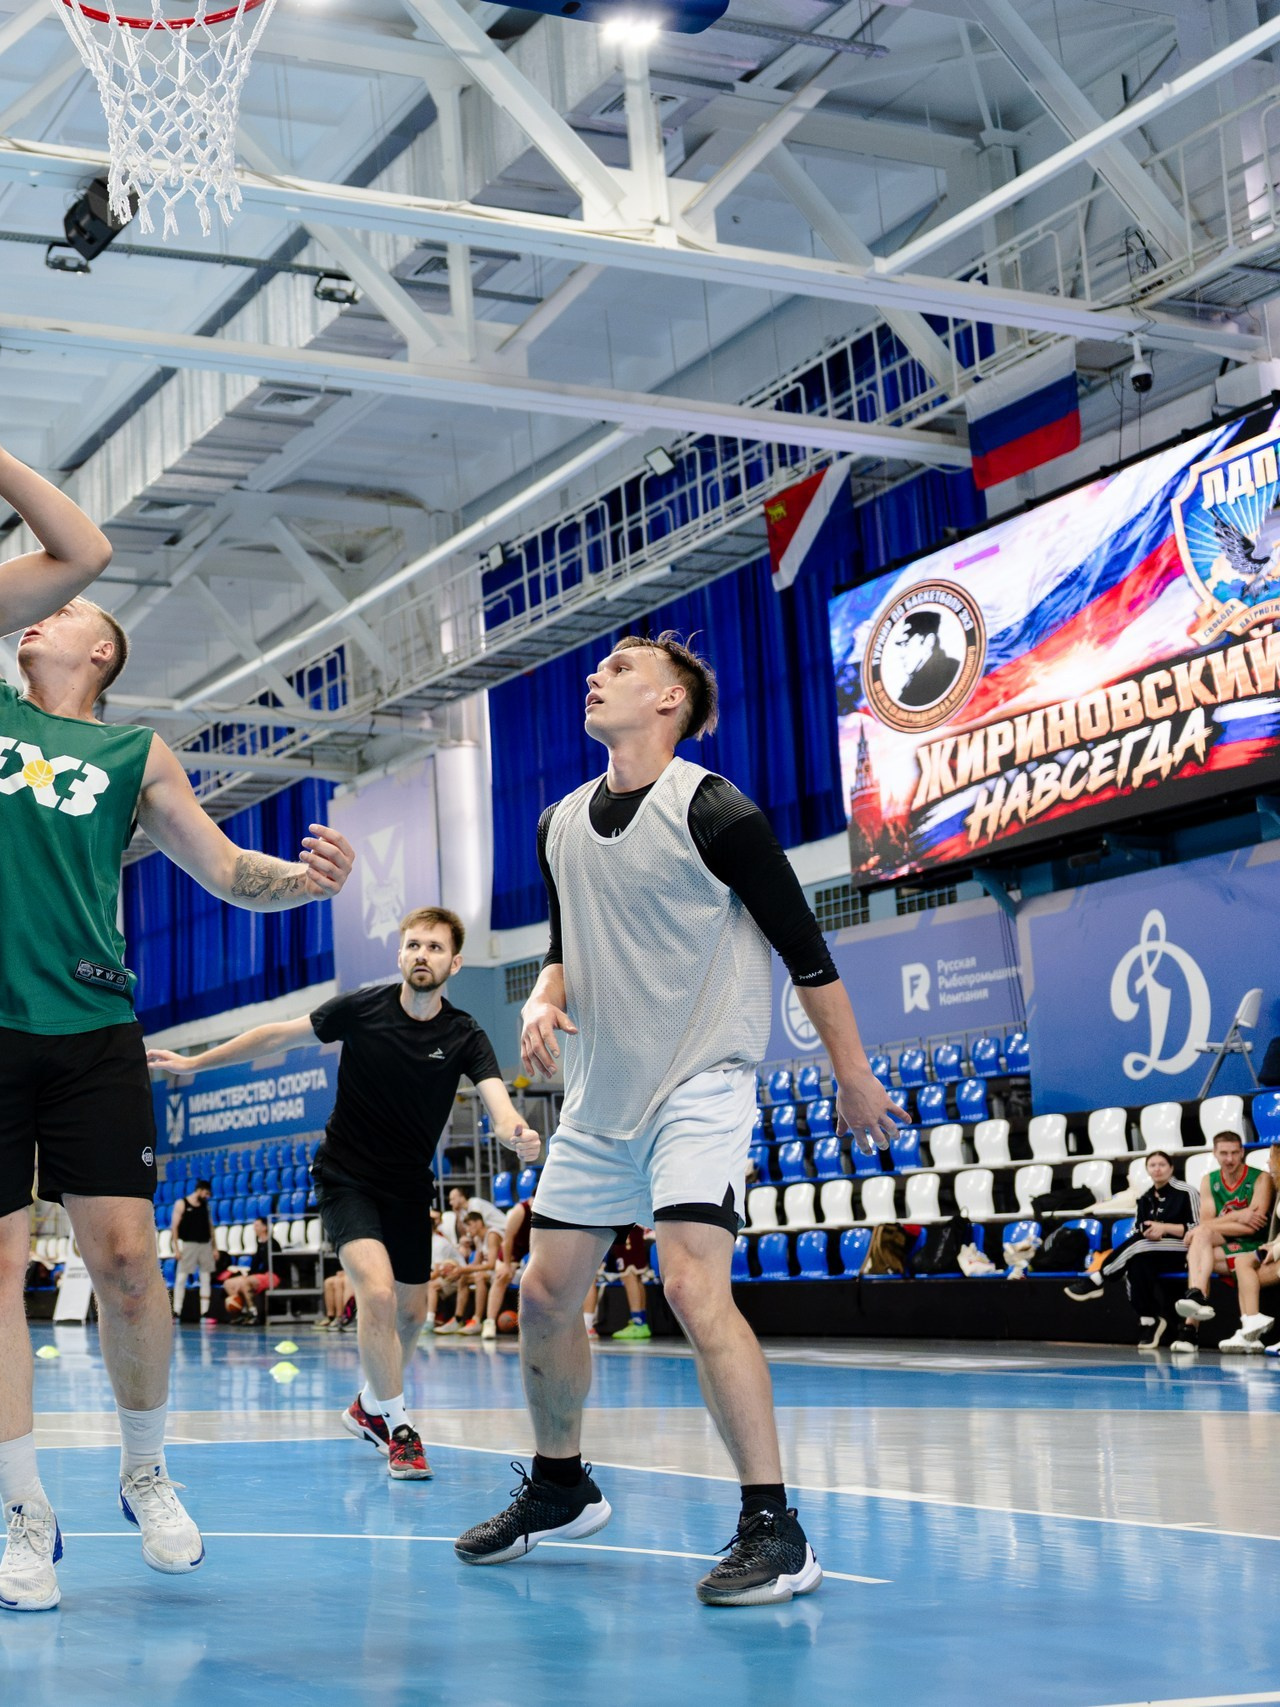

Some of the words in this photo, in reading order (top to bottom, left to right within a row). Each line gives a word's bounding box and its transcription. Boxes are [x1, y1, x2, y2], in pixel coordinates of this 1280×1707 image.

[871, 619, 893, 666] ТУРНИР
[890, 605, 906, 623] ПО
[904, 590, 965, 613] БАСКЕТБОЛУ
[911, 623, 1280, 811] ЖИРИНОВСКИЙ
[964, 706, 1214, 847] НАВСЕГДА
[937, 956, 977, 975] Русская
[939, 988, 989, 1006] Компания
[188, 1078, 276, 1114] МИНИСТЕРСТВО
[277, 1067, 328, 1097] СПОРТА
[189, 1104, 269, 1136] ПРИМОРСКОГО
[270, 1097, 305, 1123] КРАЯ
